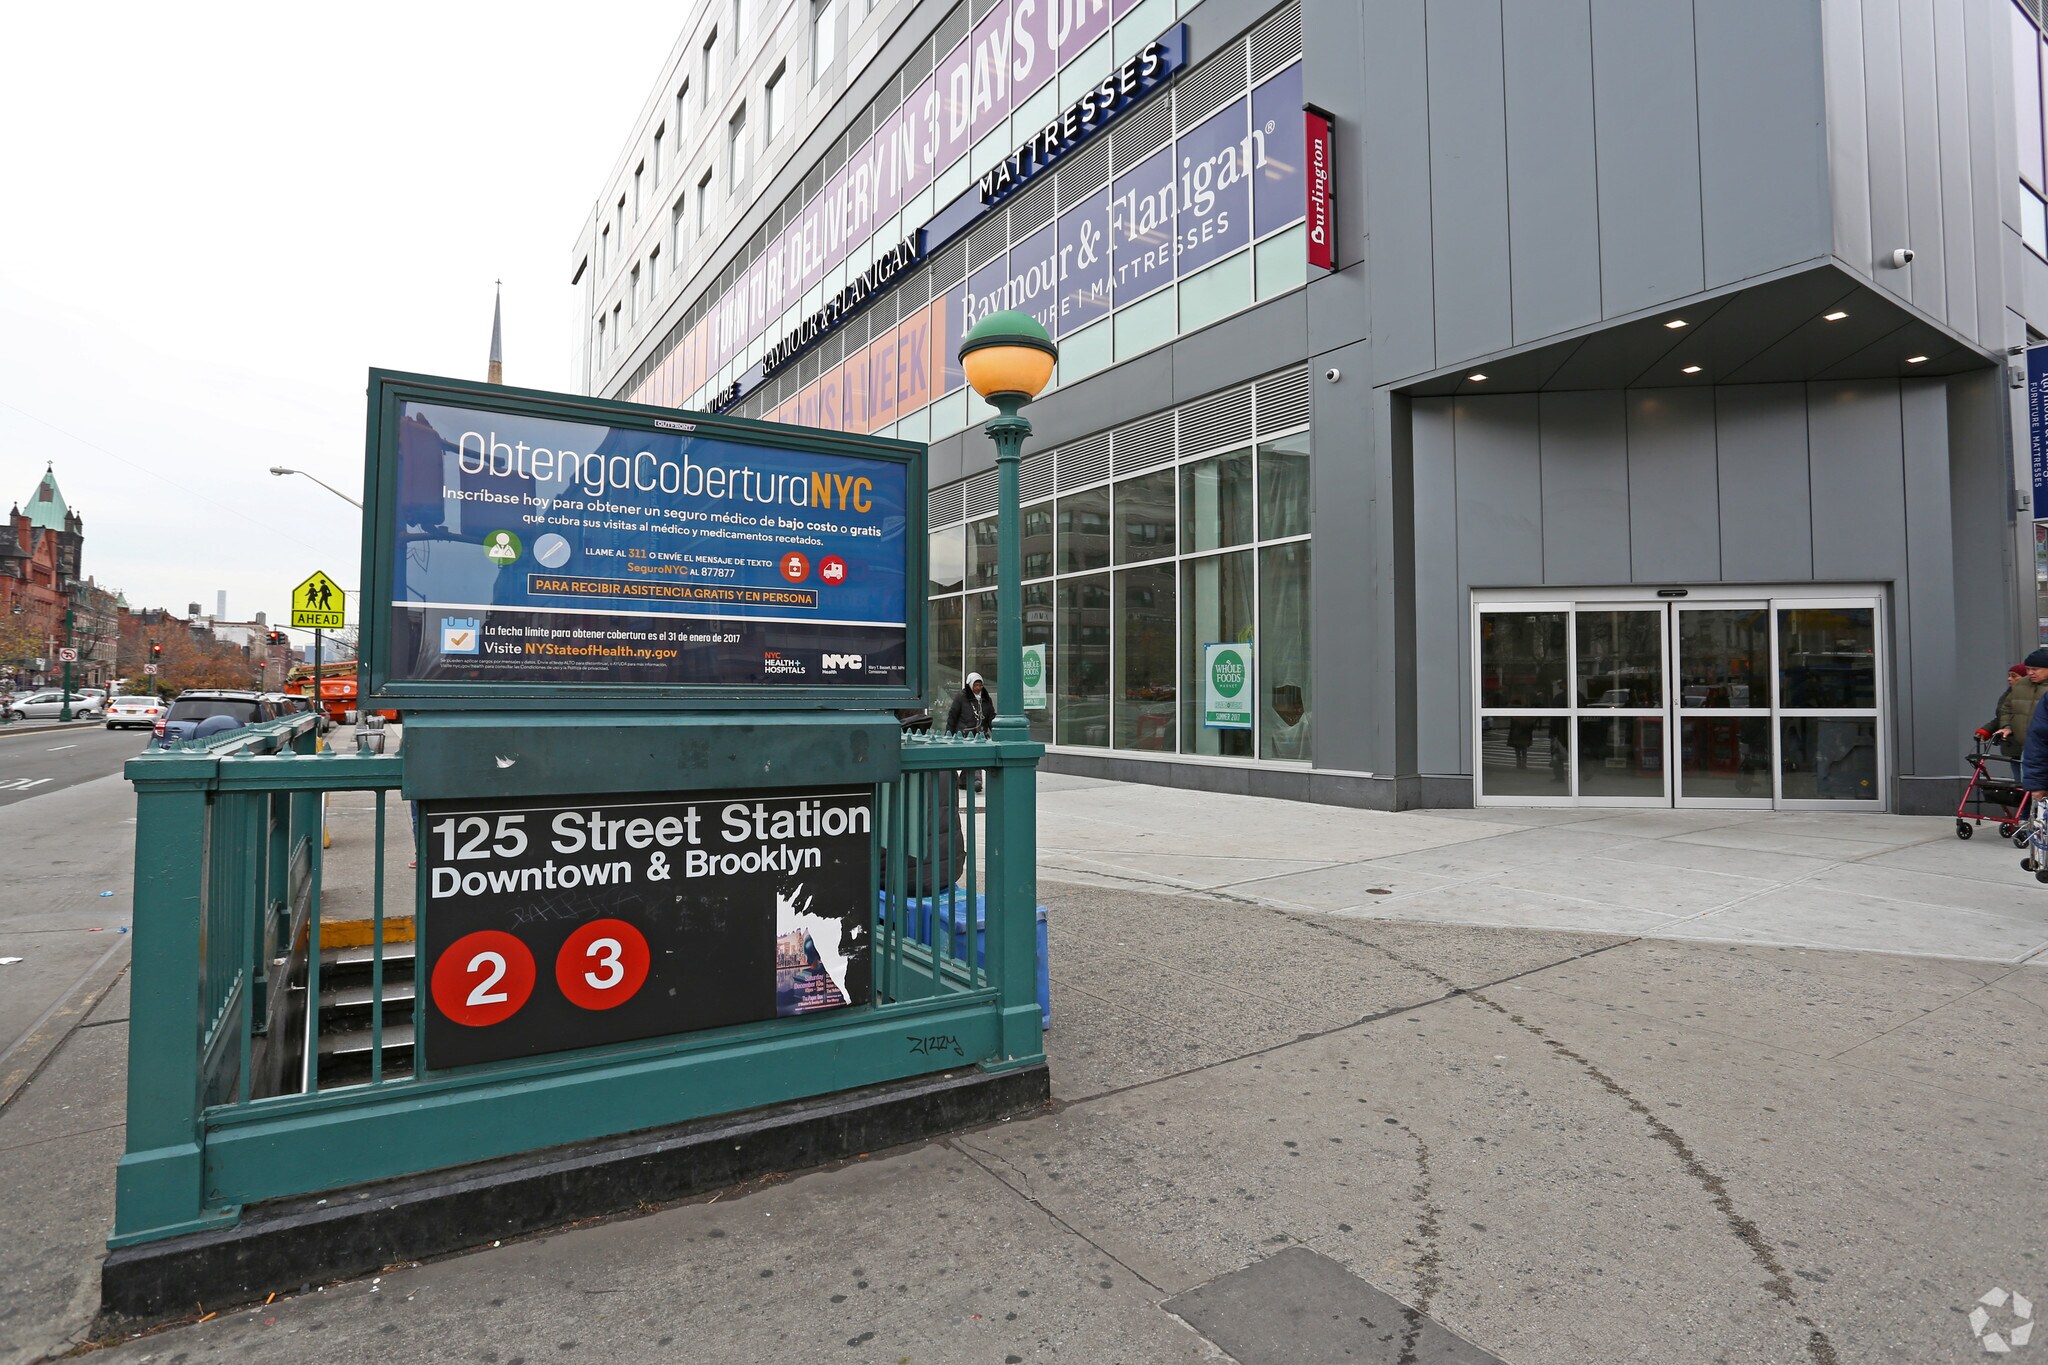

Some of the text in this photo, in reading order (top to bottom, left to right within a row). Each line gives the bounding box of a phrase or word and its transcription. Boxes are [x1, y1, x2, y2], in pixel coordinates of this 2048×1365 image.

[790, 143, 885, 290] DELIVERY
[889, 111, 916, 198] IN
[923, 89, 941, 164] 3
[949, 0, 1036, 144] DAYS
[979, 41, 1160, 204] MATTRESSES
[1310, 138, 1329, 245] Burlington
[1077, 219, 1101, 269] &
[1091, 211, 1229, 301] MATTRESSES
[761, 310, 818, 377] RAYMOUR
[820, 302, 831, 330] &
[832, 228, 920, 321] FLANIGAN
[860, 322, 928, 422] WEEK
[2030, 382, 2042, 487] FURNITURE MATTRESSES
[442, 485, 882, 538] Inscríbase hoy para obtener un seguro médico de bajo costo o gratis
[522, 514, 824, 547] que cubra sus visitas al médico y medicamentos recetados.
[585, 548, 773, 568] LLAME AL 311 O ENVÍE EL MENSAJE DE TEXTO
[627, 562, 736, 578] SeguroNYC AL 877877
[535, 579, 813, 604] PARA RECIBIR ASISTENCIA GRATIS Y EN PERSONA
[297, 613, 339, 625] AHEAD
[485, 626, 741, 643] La fecha límite para obtener cobertura es el 31 de enero de 2017
[484, 642, 678, 660] Visite NYStateofHealth.ny.gov
[764, 666, 806, 674] HOSPITALS
[822, 653, 862, 669] NYC
[1215, 663, 1242, 674] WHOLE
[1216, 673, 1241, 682] FOODS
[431, 800, 871, 861] 125 Street Station
[432, 843, 821, 899] Downtown & Brooklyn
[465, 951, 508, 1007] 2
[584, 937, 624, 990] 3
